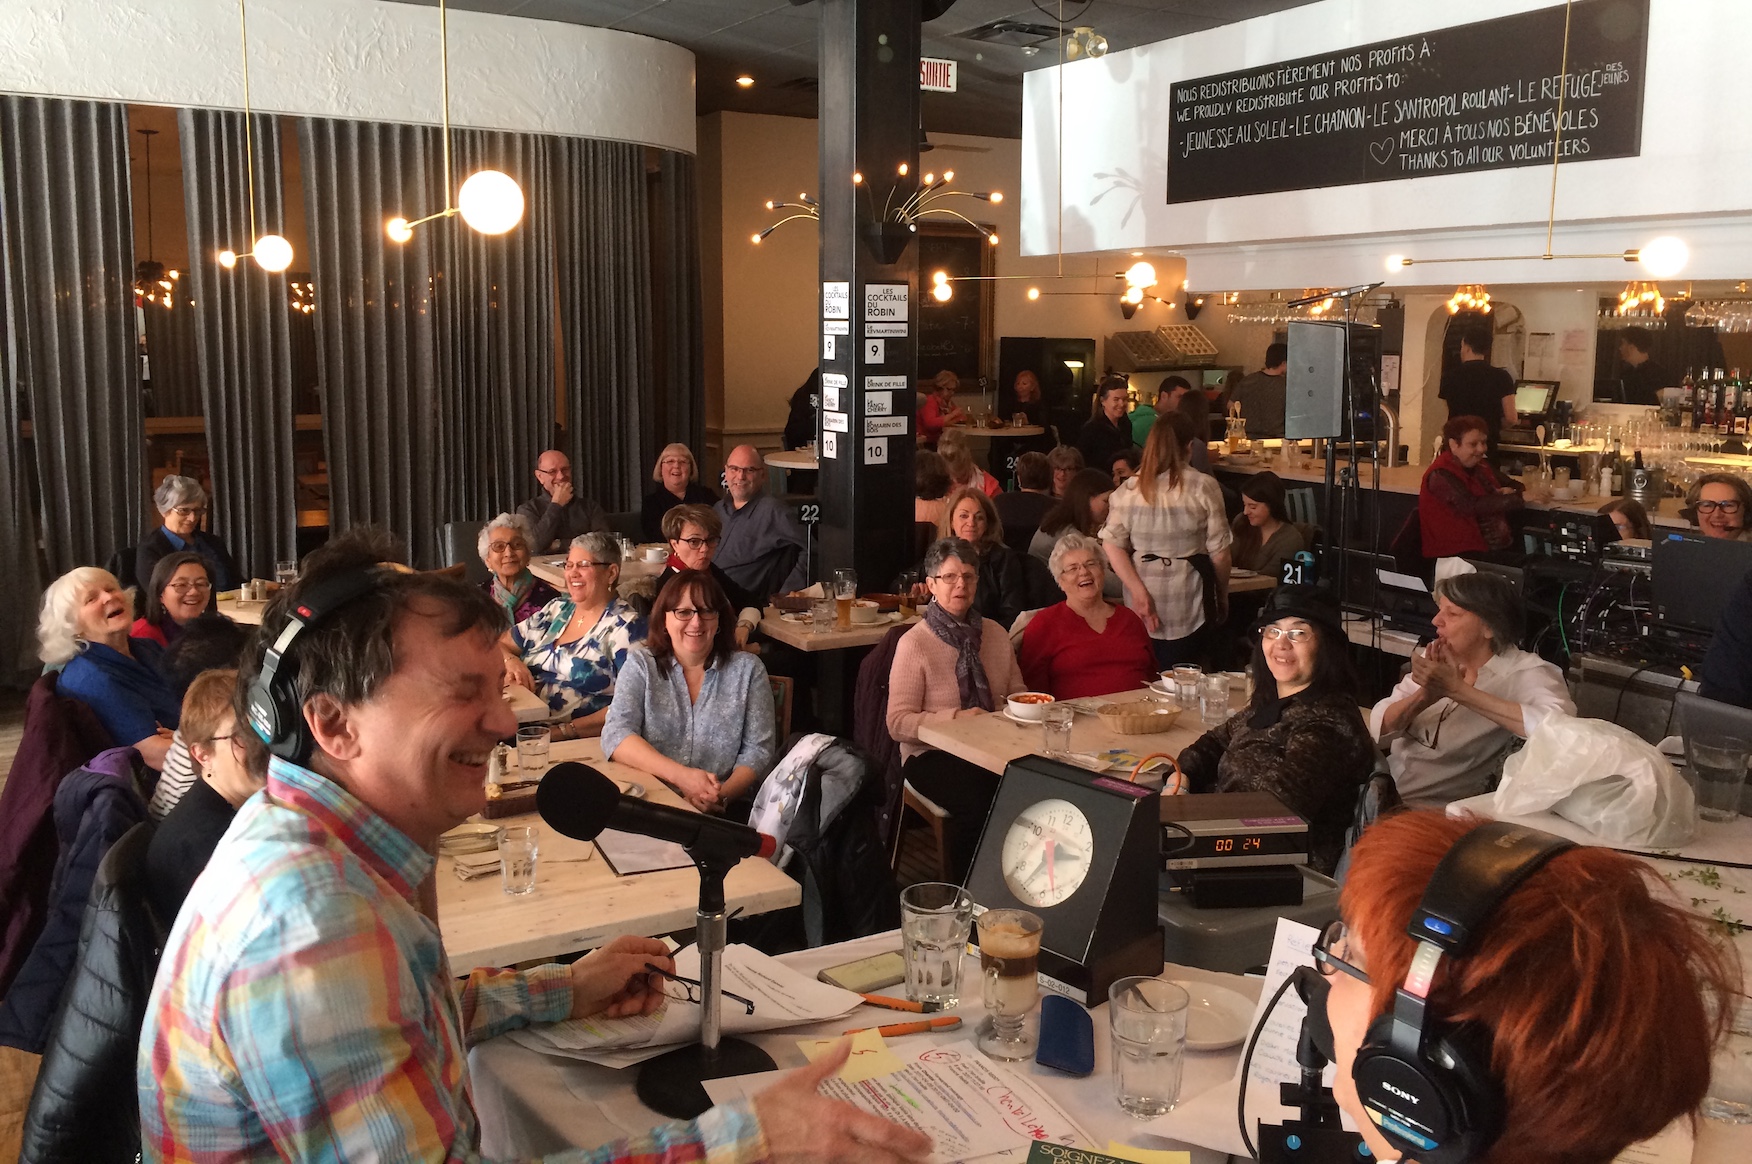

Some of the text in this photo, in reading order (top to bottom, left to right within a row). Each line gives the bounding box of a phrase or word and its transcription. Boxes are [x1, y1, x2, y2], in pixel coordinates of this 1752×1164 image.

[1177, 88, 1198, 104] NOUS
[1200, 72, 1274, 100] REDISTRIBUONS
[1277, 60, 1335, 85] FIÈREMENT
[1340, 54, 1362, 73] NOS
[1368, 42, 1415, 68] PROFITS
[1606, 62, 1623, 71] DES
[920, 60, 952, 88] SORTIE
[1598, 70, 1630, 87] JEUNES
[1176, 110, 1190, 123] WE
[1194, 103, 1232, 120] PROUDLY
[1236, 87, 1304, 113] REDISTRIBUTE
[1310, 82, 1330, 100] OUR
[1334, 74, 1384, 97] PROFITS
[1236, 126, 1251, 144] AU
[1394, 93, 1460, 123] SANTROPOL
[1541, 70, 1601, 100] REFUGE
[1400, 108, 1599, 148] MERCI À TOUS NOS BÉNÉVOLES
[1399, 150, 1448, 170] THANKS
[1450, 149, 1464, 167] TO
[1482, 146, 1503, 162] OUR
[1509, 138, 1590, 162] VOLUNTEERS
[828, 342, 832, 352] 9
[825, 440, 833, 451] 10
[801, 504, 819, 520] 22
[1283, 563, 1301, 584] 21
[1048, 815, 1056, 826] 11
[1063, 814, 1073, 826] 12
[1032, 825, 1042, 836] 10
[1022, 841, 1028, 850] 9
[1085, 842, 1092, 852] 2
[1216, 838, 1261, 851] 00 24
[1020, 861, 1026, 871] 8
[1056, 890, 1064, 899] 5
[1040, 976, 1070, 994] S-02-012
[1382, 1082, 1420, 1104] SONY
